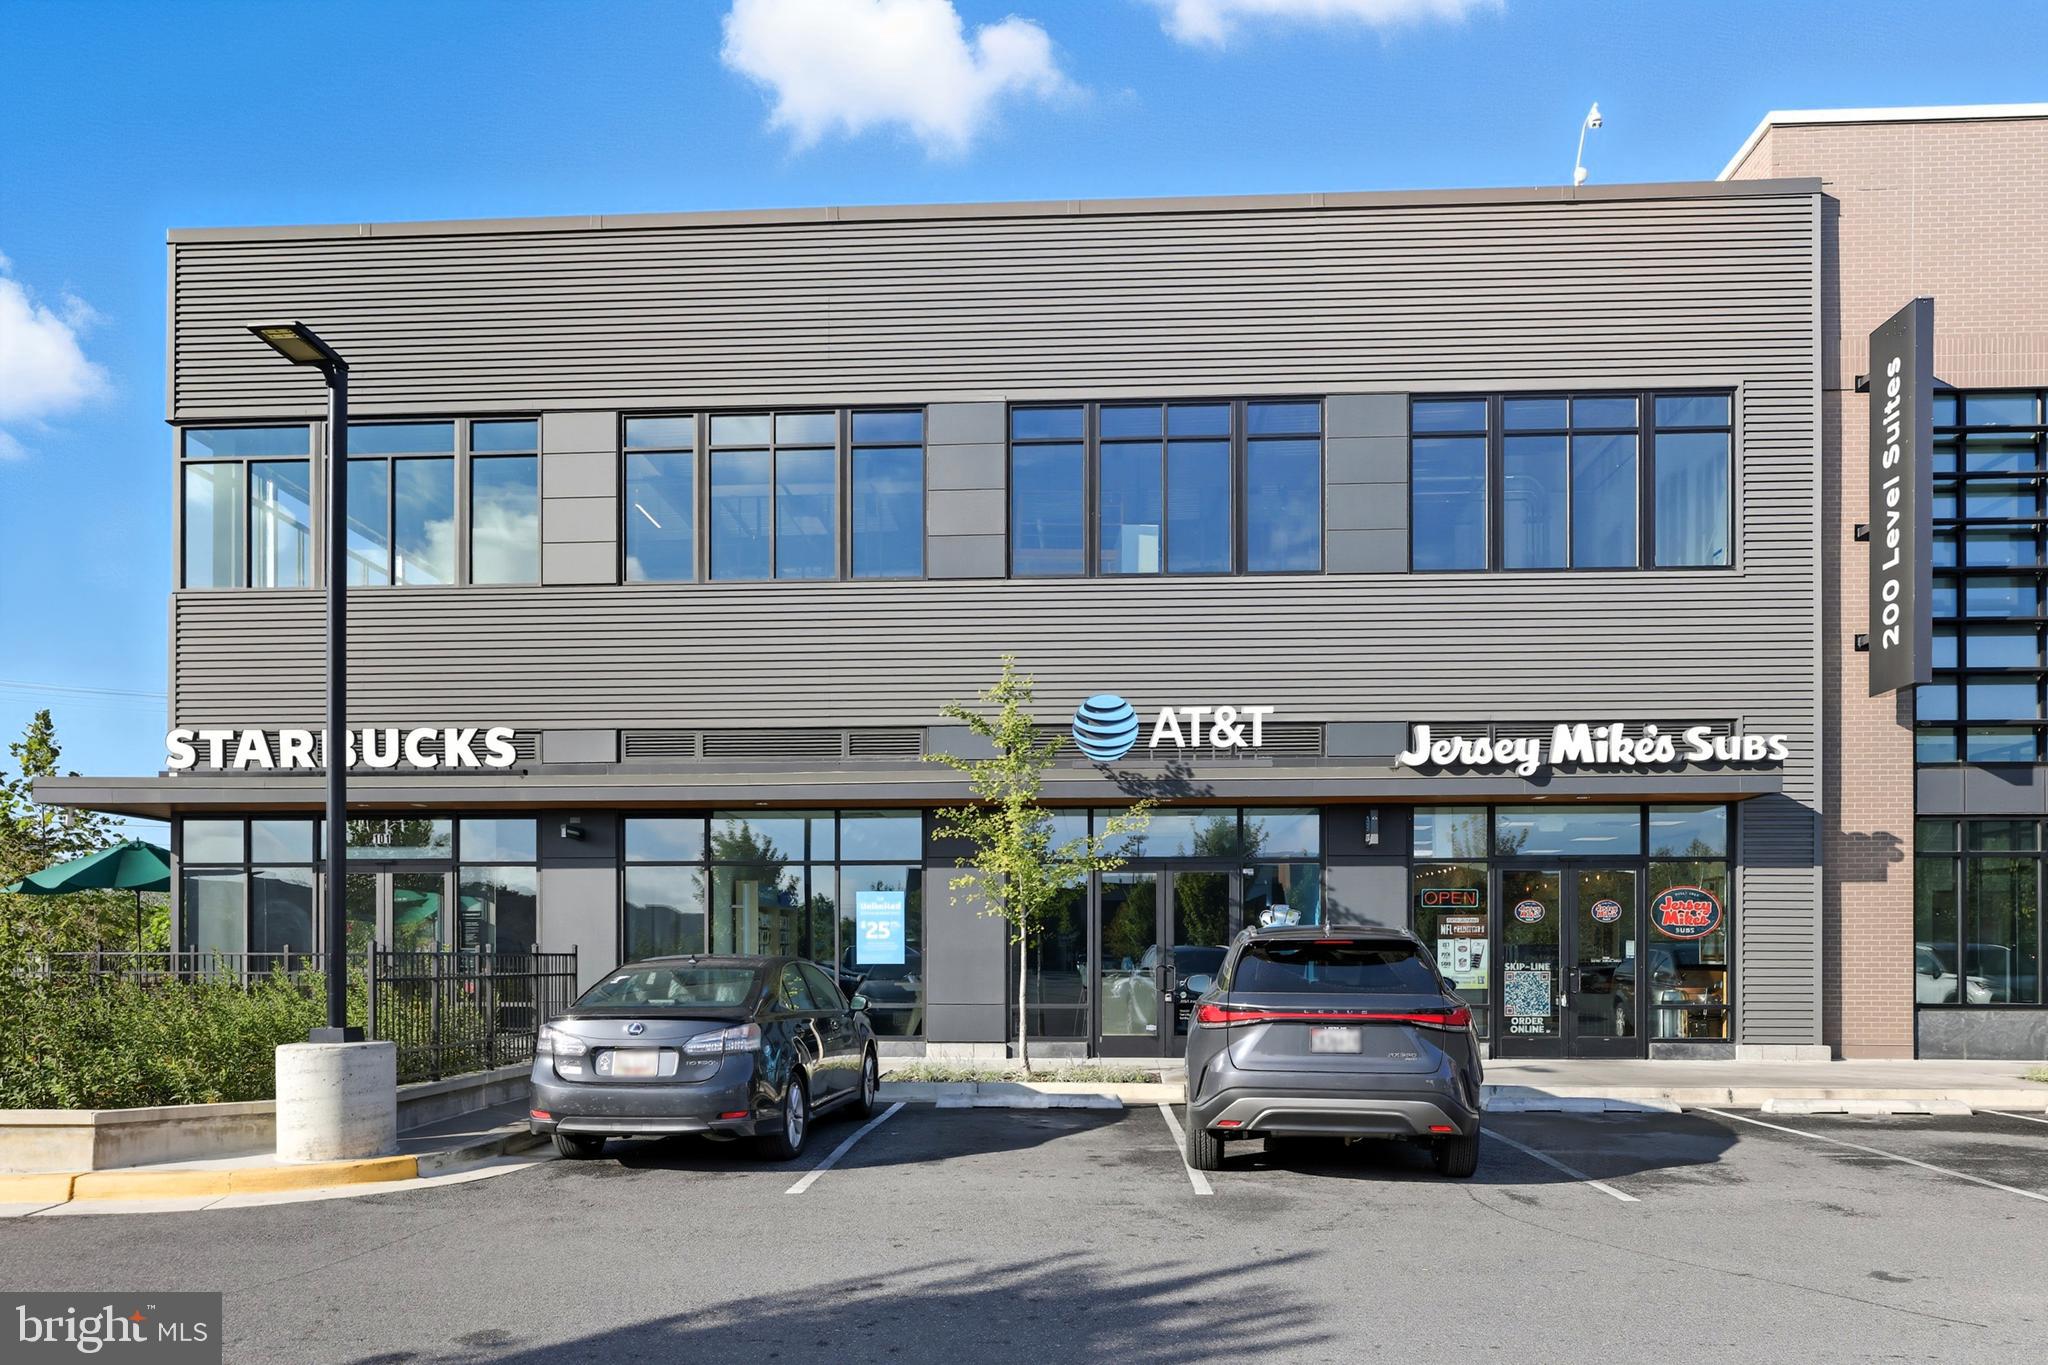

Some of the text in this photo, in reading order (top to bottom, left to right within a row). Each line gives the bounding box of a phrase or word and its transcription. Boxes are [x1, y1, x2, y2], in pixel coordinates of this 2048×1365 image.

[1882, 356, 1901, 650] 200 Level Suites
[1149, 706, 1274, 748] AT&T
[1400, 724, 1541, 777] Jersey
[1547, 723, 1676, 766] Mike's
[372, 833, 391, 844] 101
[1424, 891, 1475, 905] OPEN
[1659, 896, 1712, 917] Jersey
[1440, 923, 1453, 935] NFL
[1504, 962, 1552, 971] SKIP-LINE
[1511, 1017, 1544, 1025] ORDER
[1510, 1026, 1545, 1034] ONLINE
